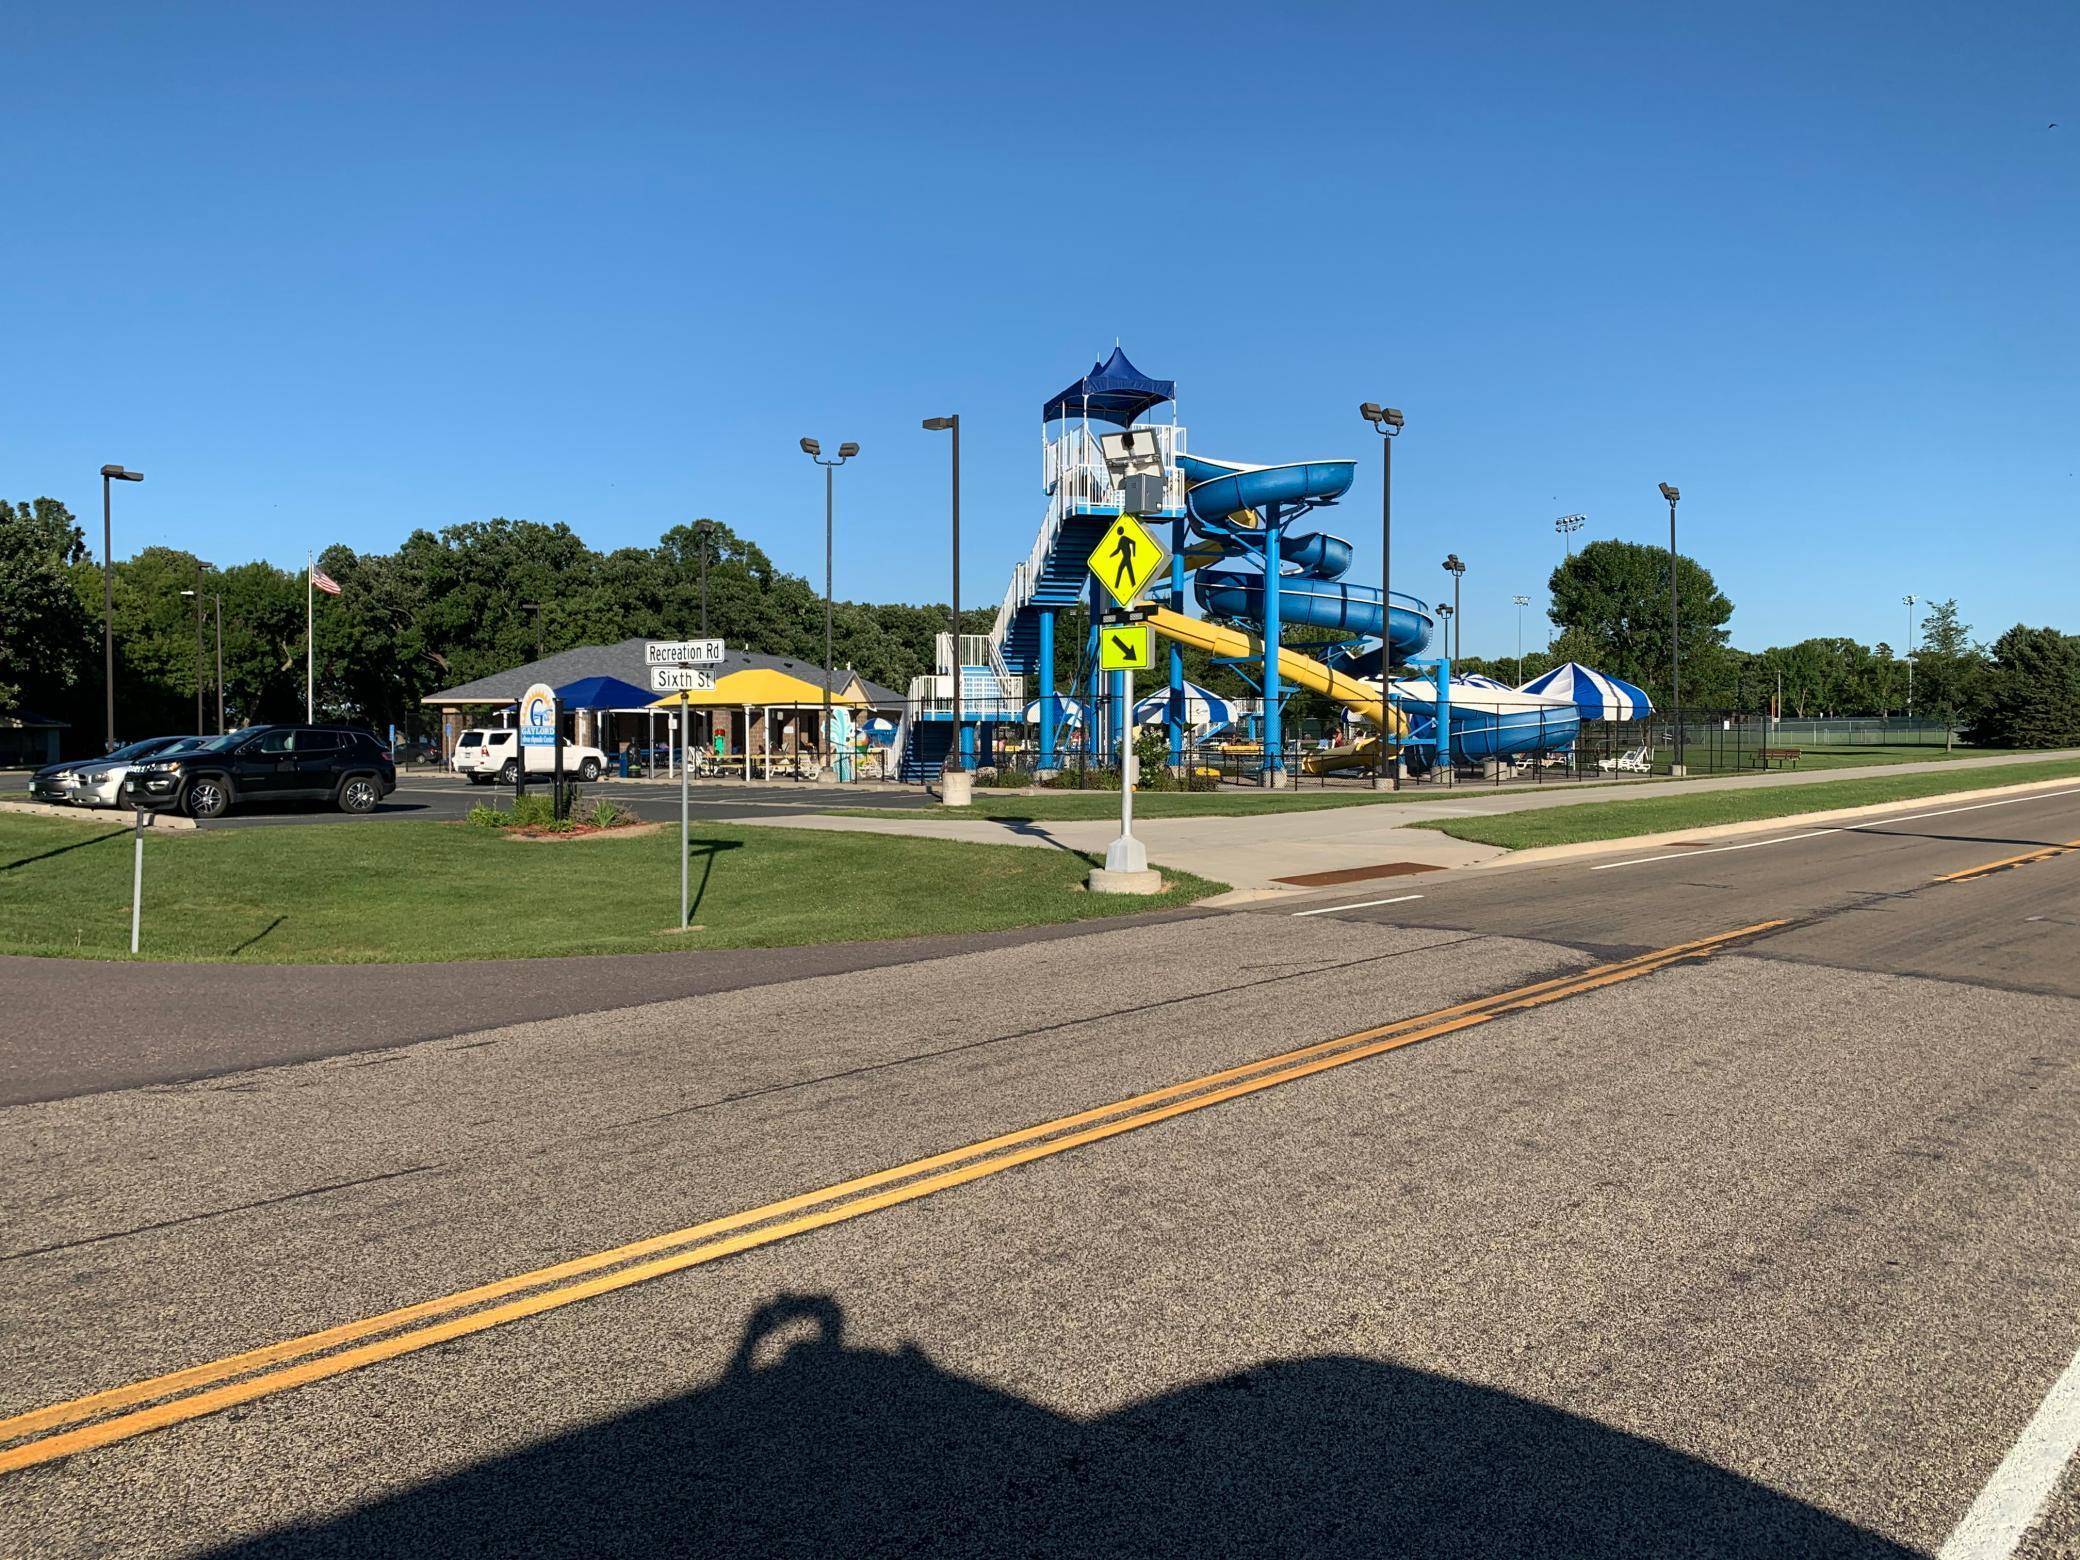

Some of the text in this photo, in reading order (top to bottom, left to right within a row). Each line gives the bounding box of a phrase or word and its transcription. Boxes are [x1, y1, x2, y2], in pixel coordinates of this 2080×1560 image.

[650, 643, 719, 661] Recreation Rd
[658, 670, 711, 688] Sixth St
[521, 727, 555, 735] GAYLORD
